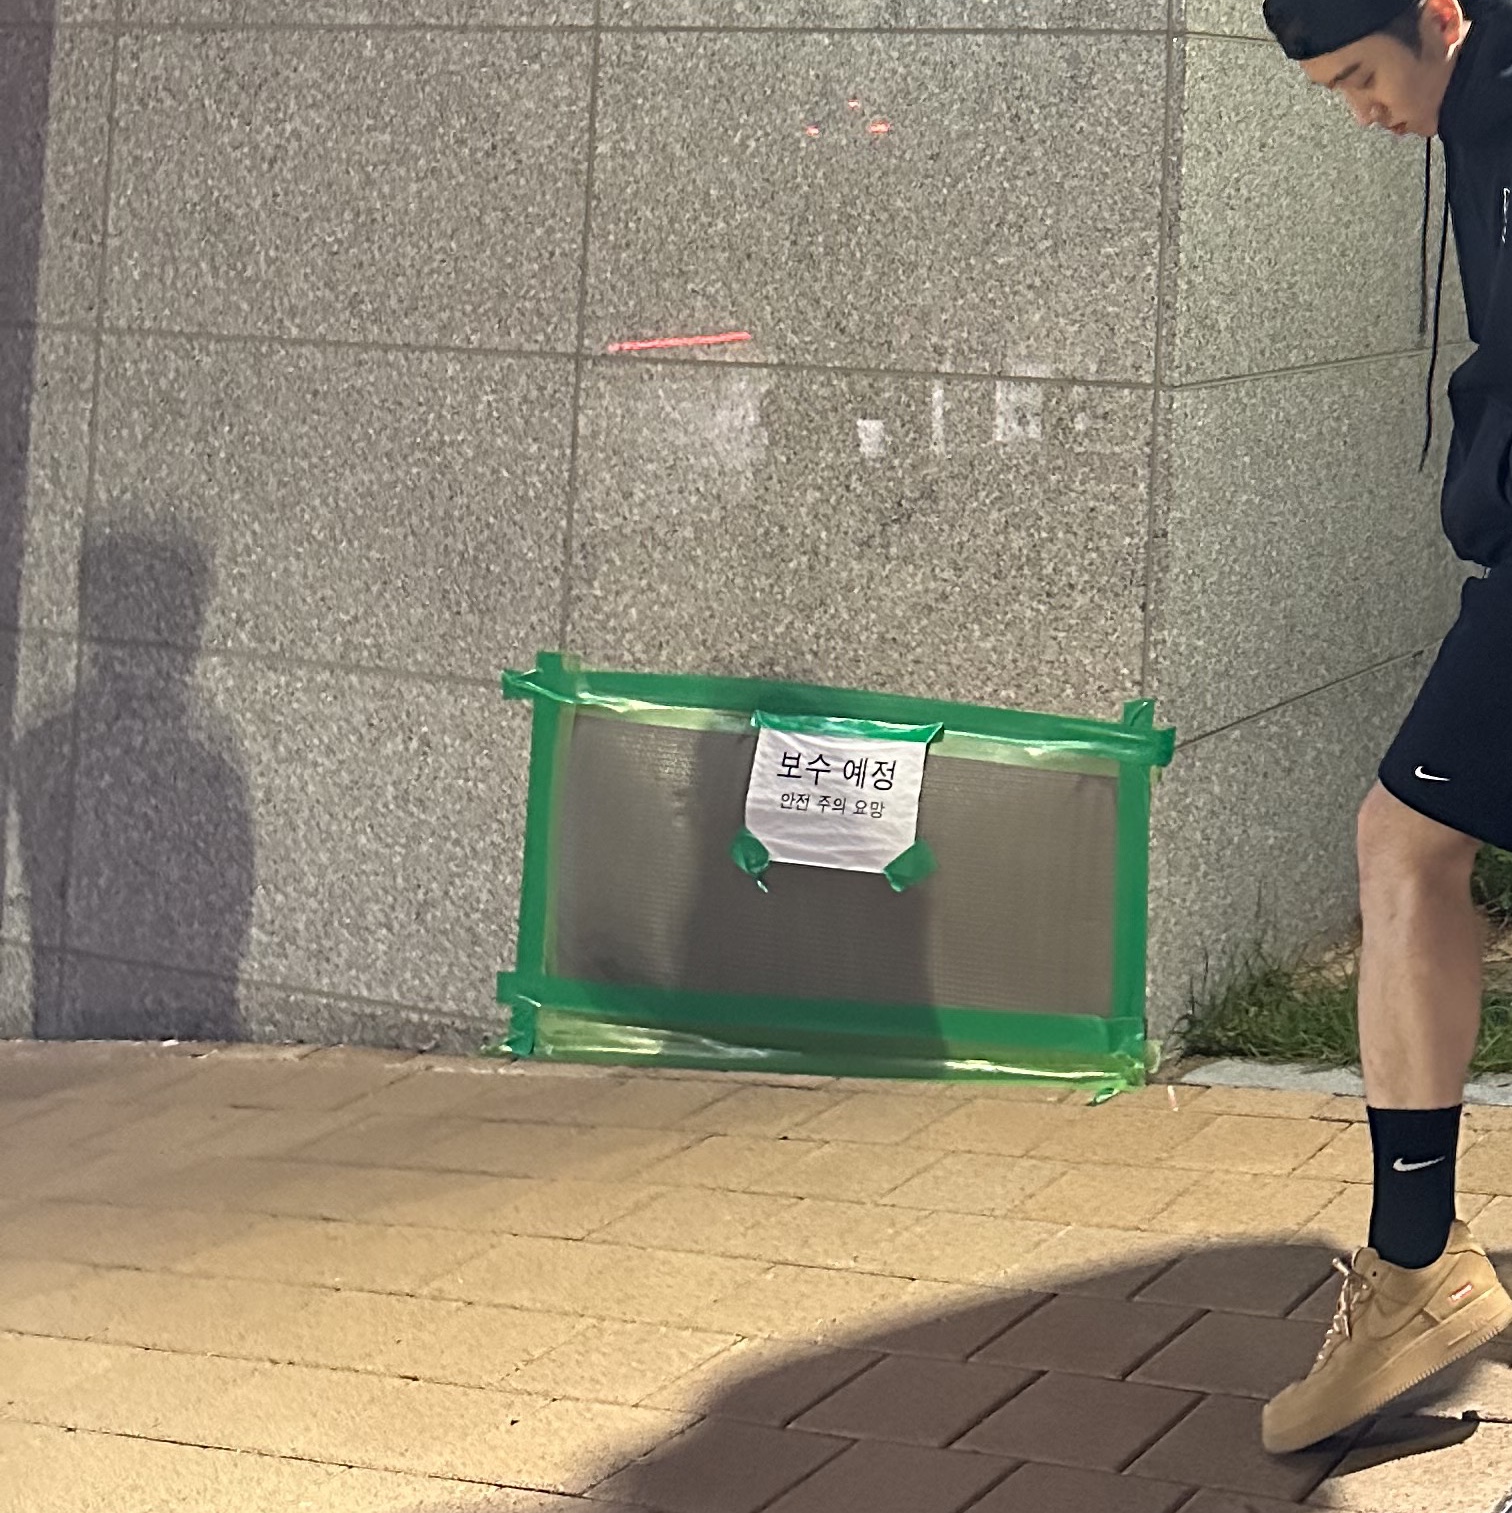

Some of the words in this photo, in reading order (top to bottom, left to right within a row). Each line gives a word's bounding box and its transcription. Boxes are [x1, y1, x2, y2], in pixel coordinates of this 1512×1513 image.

[776, 751, 832, 786] 보수
[843, 757, 897, 791] 예정
[779, 791, 811, 812] 안전
[816, 795, 847, 815] 주의
[852, 799, 886, 819] 요망
